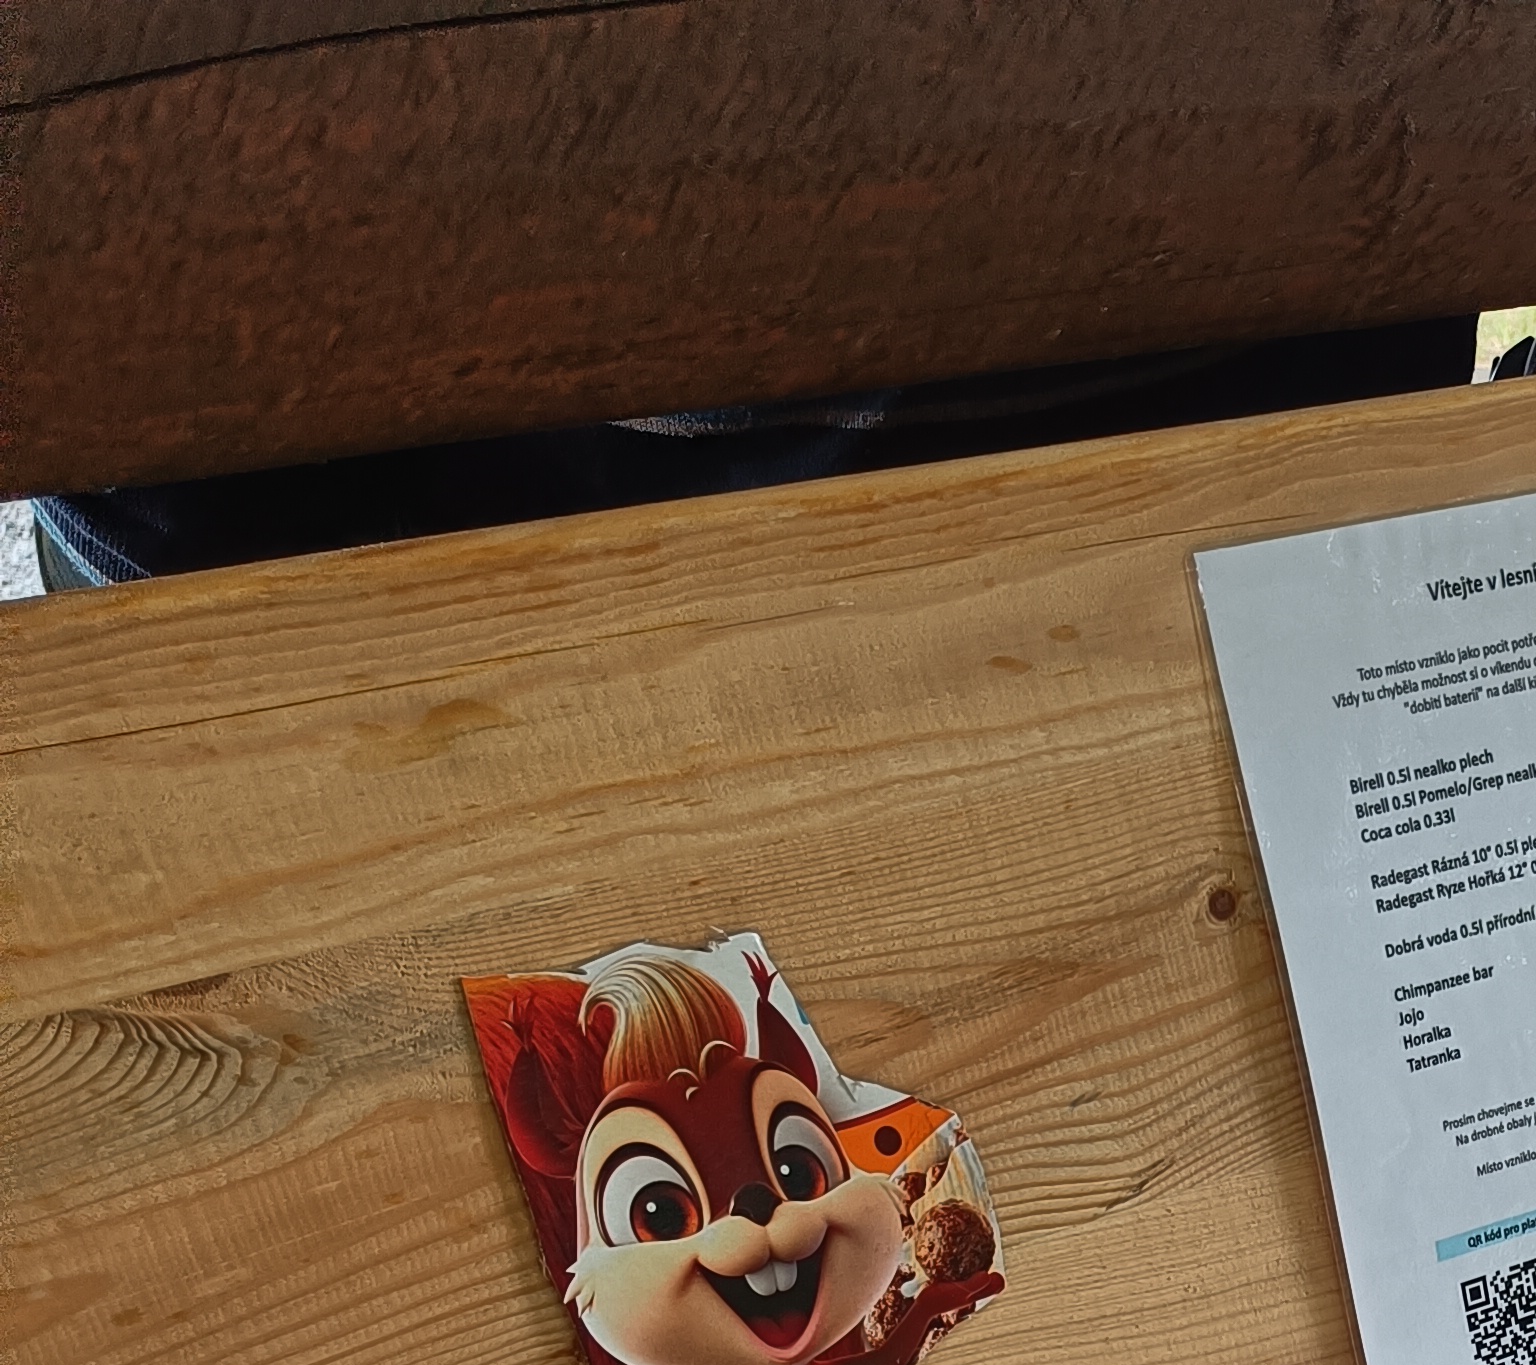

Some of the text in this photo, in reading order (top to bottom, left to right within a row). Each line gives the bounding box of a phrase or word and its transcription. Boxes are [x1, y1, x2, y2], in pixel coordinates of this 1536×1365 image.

[1426, 575, 1484, 601] Vítejte
[1356, 667, 1384, 682] Toto
[1384, 659, 1417, 677] místo
[1417, 649, 1456, 669] vzniklo
[1456, 645, 1481, 665] jako
[1482, 639, 1510, 660] pocit
[1331, 691, 1360, 709] Vždy
[1361, 690, 1375, 703] tu
[1376, 679, 1419, 701] chyběla
[1420, 670, 1469, 691] možnost
[1469, 665, 1479, 681] si
[1489, 655, 1532, 676] víkendu
[1403, 694, 1443, 715] "dobití
[1485, 686, 1501, 699] na
[1501, 677, 1527, 696] další
[1349, 772, 1385, 795] Birell
[1413, 758, 1457, 781] nealko
[1458, 748, 1494, 773] plech
[1354, 796, 1390, 819] Birell
[1418, 774, 1504, 805] Pomelo/Grep
[1360, 826, 1393, 844] Coca
[1394, 816, 1422, 836] cola
[1370, 863, 1430, 890] Radegast
[1430, 850, 1471, 875] Rázná
[1375, 887, 1436, 914] Radegast
[1435, 881, 1467, 900] Ryze
[1467, 867, 1506, 891] Hořká
[1384, 934, 1425, 959] Dobrá
[1425, 927, 1459, 947] voda
[1485, 904, 1536, 936] přírodní
[1394, 965, 1494, 1002] Chimpanzee bar
[1399, 1007, 1425, 1027] Jojo
[1402, 1025, 1452, 1050] Horalka
[1405, 1046, 1462, 1073] Tatranka
[1467, 1234, 1484, 1248] QR
[1483, 1226, 1503, 1244] kód
[1503, 1224, 1520, 1240] pro
